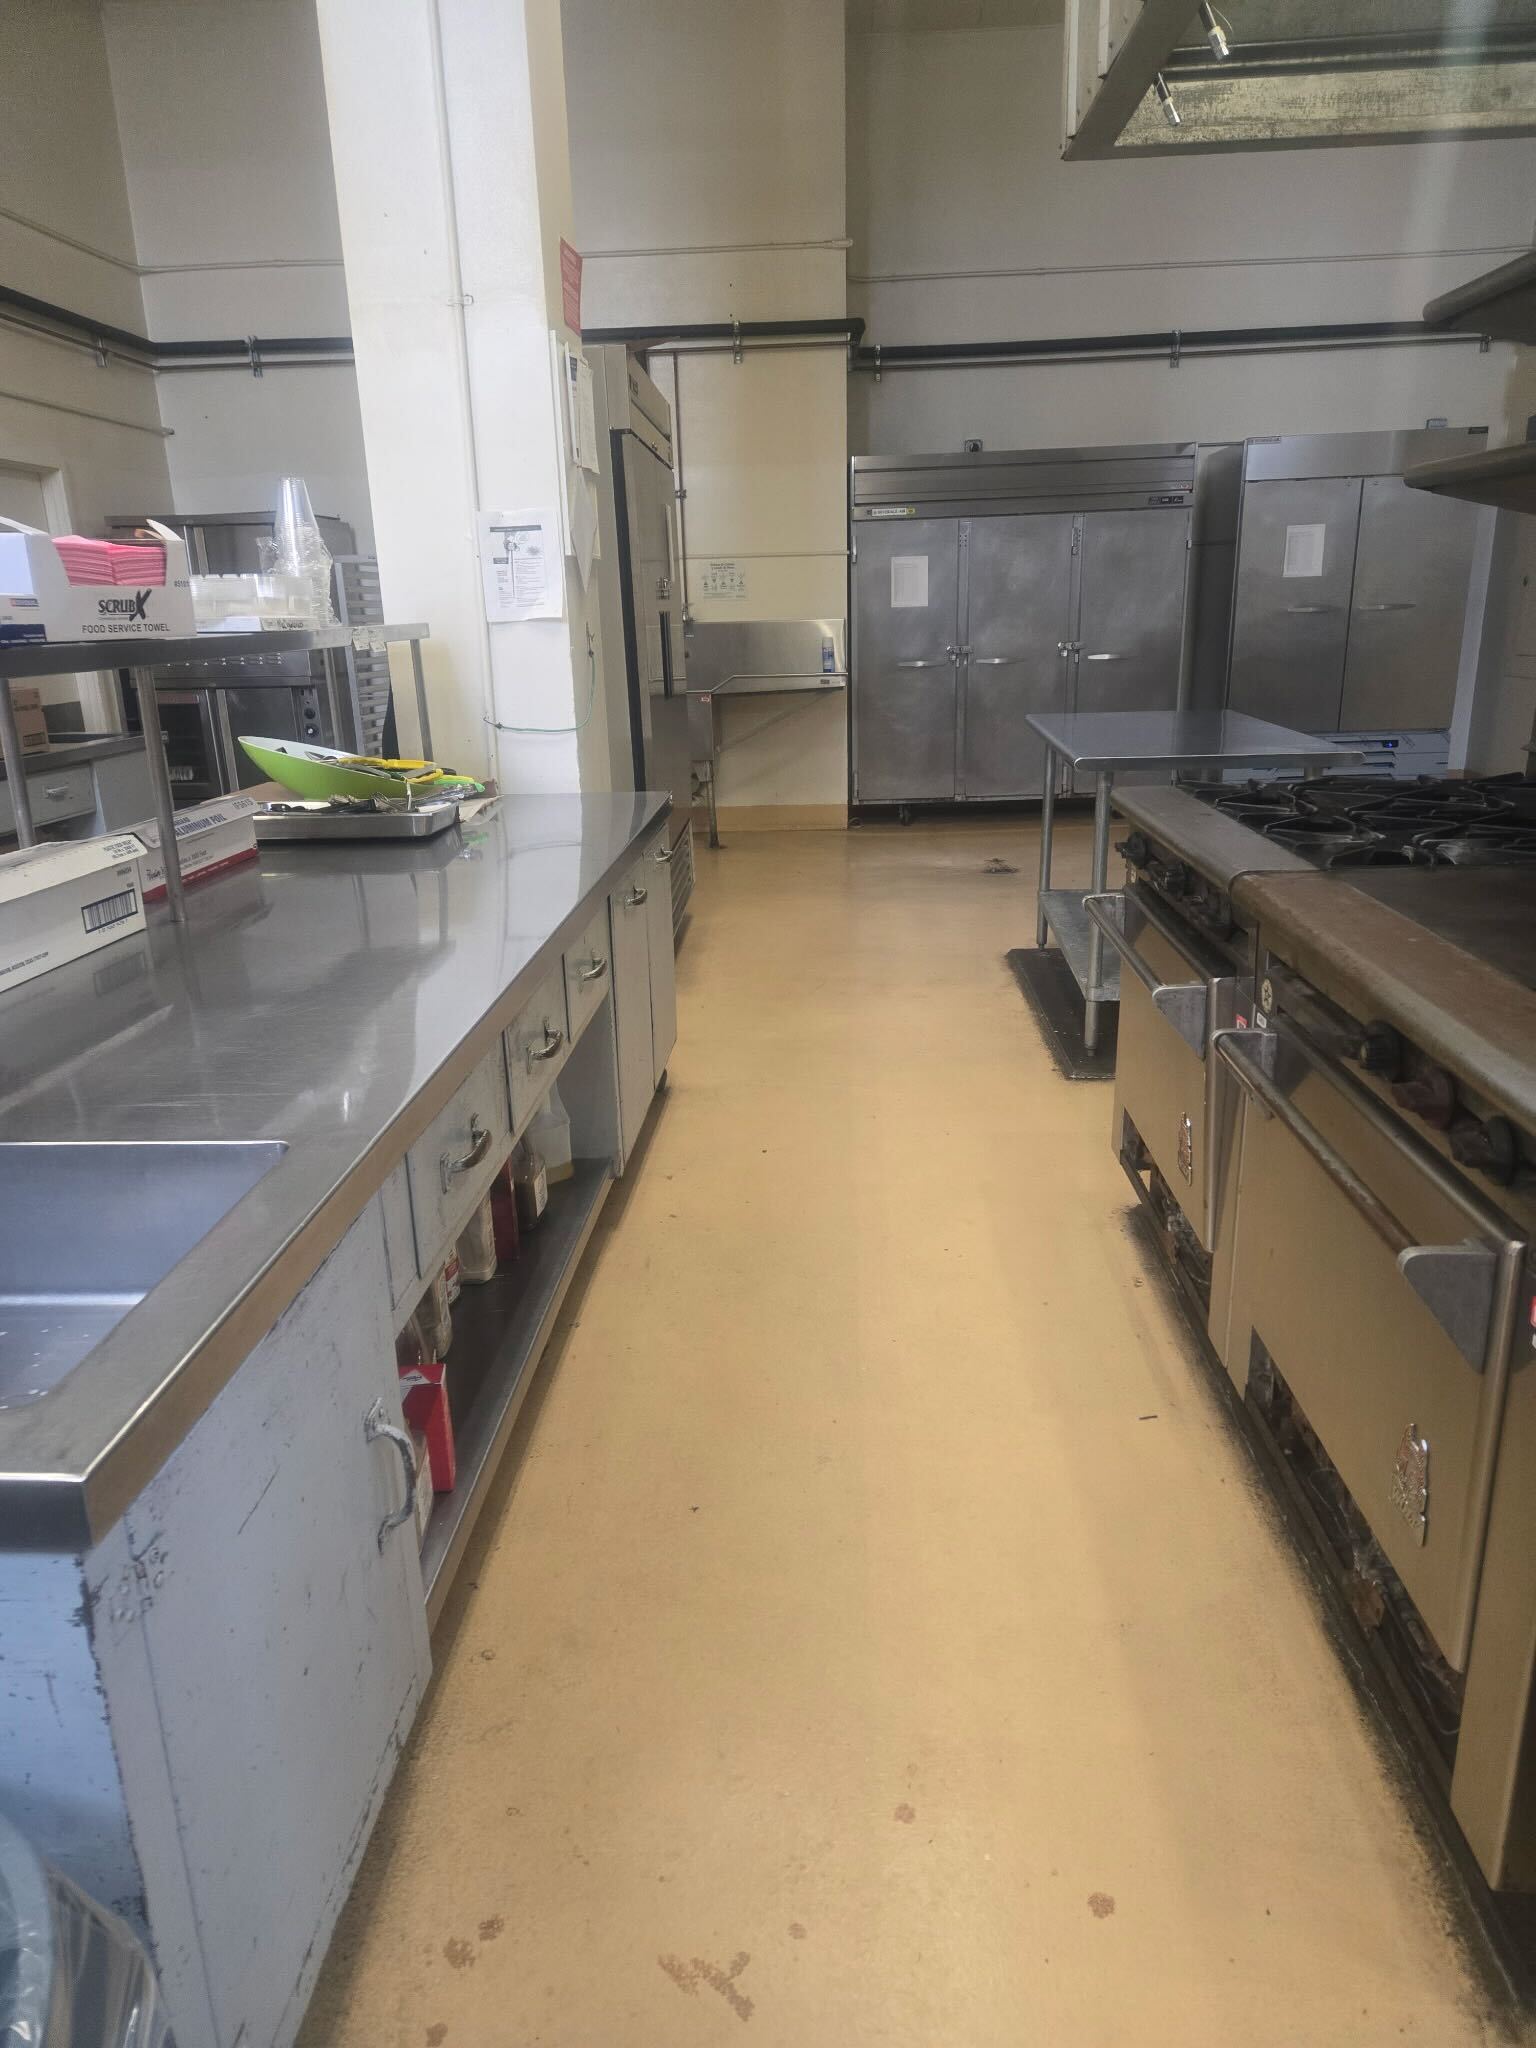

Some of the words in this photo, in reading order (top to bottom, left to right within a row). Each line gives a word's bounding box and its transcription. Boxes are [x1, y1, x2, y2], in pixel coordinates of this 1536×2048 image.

[82, 624, 106, 634] FOOD
[107, 623, 142, 633] SERVICE
[143, 623, 170, 633] TOWEL
[175, 817, 213, 837] ALUMINUM
[210, 813, 228, 825] FOIL
